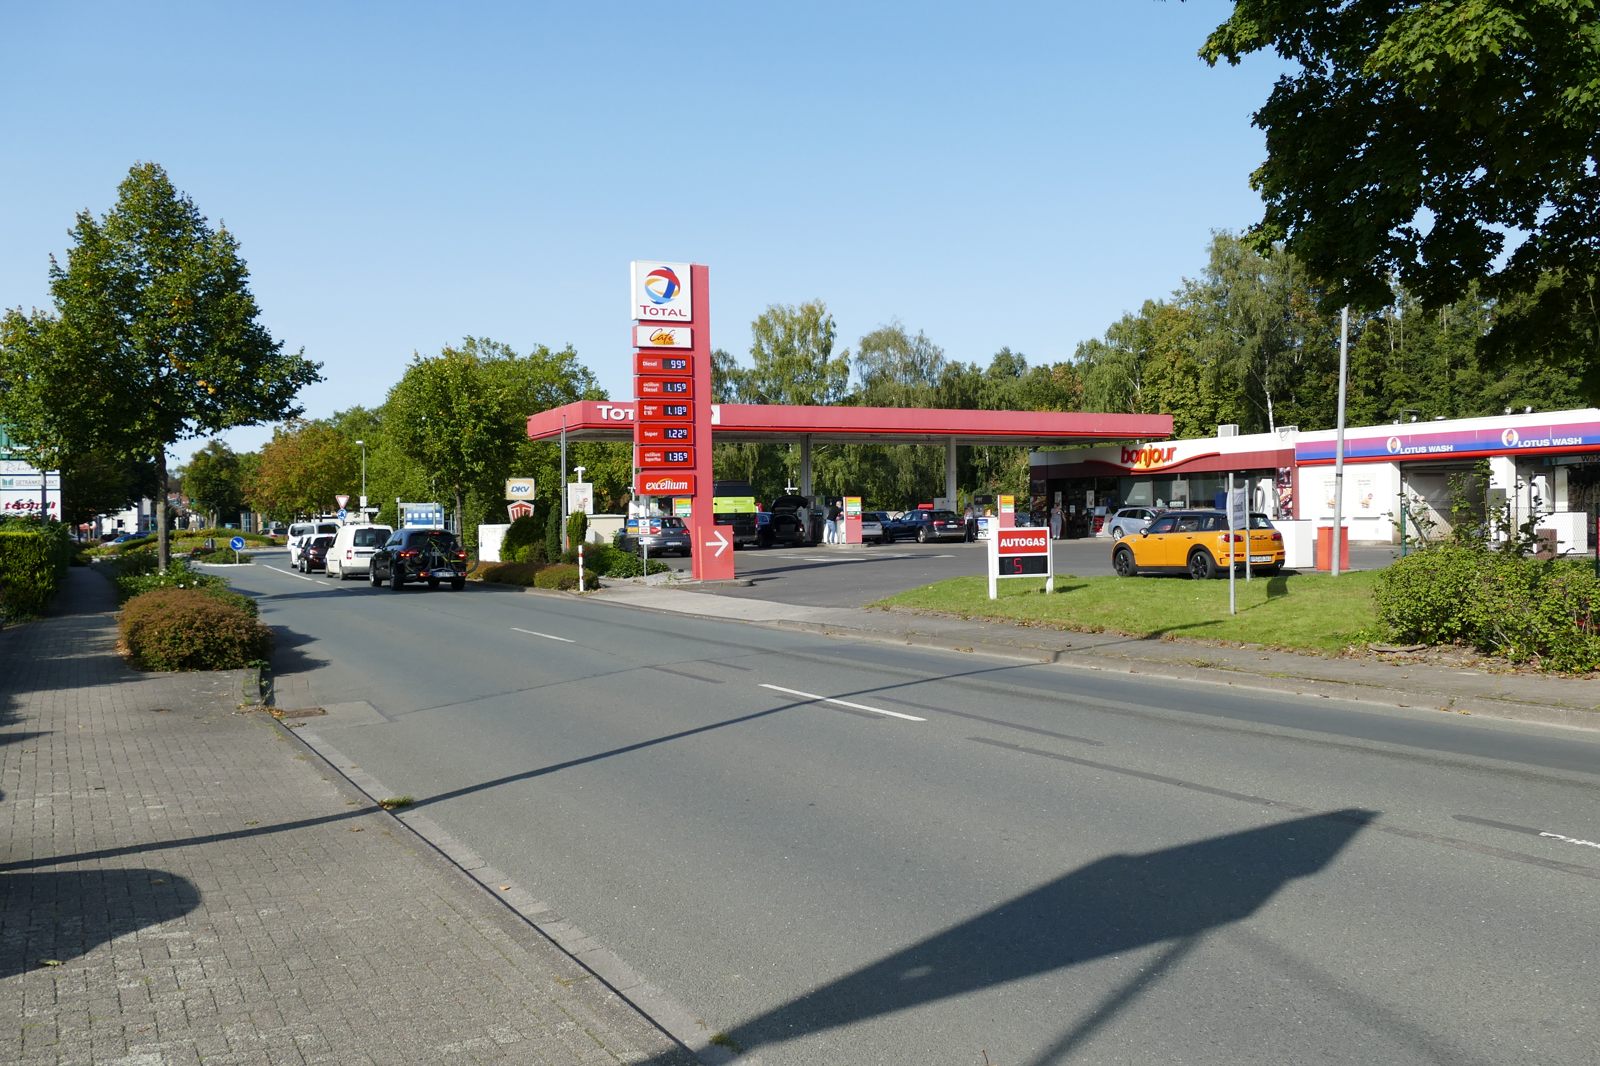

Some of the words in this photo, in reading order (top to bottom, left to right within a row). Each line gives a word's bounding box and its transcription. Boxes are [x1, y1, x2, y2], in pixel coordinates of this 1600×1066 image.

[640, 305, 687, 316] TOTAL
[597, 405, 634, 420] TOT
[1518, 439, 1549, 447] LOTUS
[1552, 437, 1582, 445] WASH
[1400, 446, 1427, 454] LOTUS
[1121, 444, 1177, 468] bonjour
[646, 480, 688, 491] excellium
[1000, 538, 1046, 547] AUTOGAS
